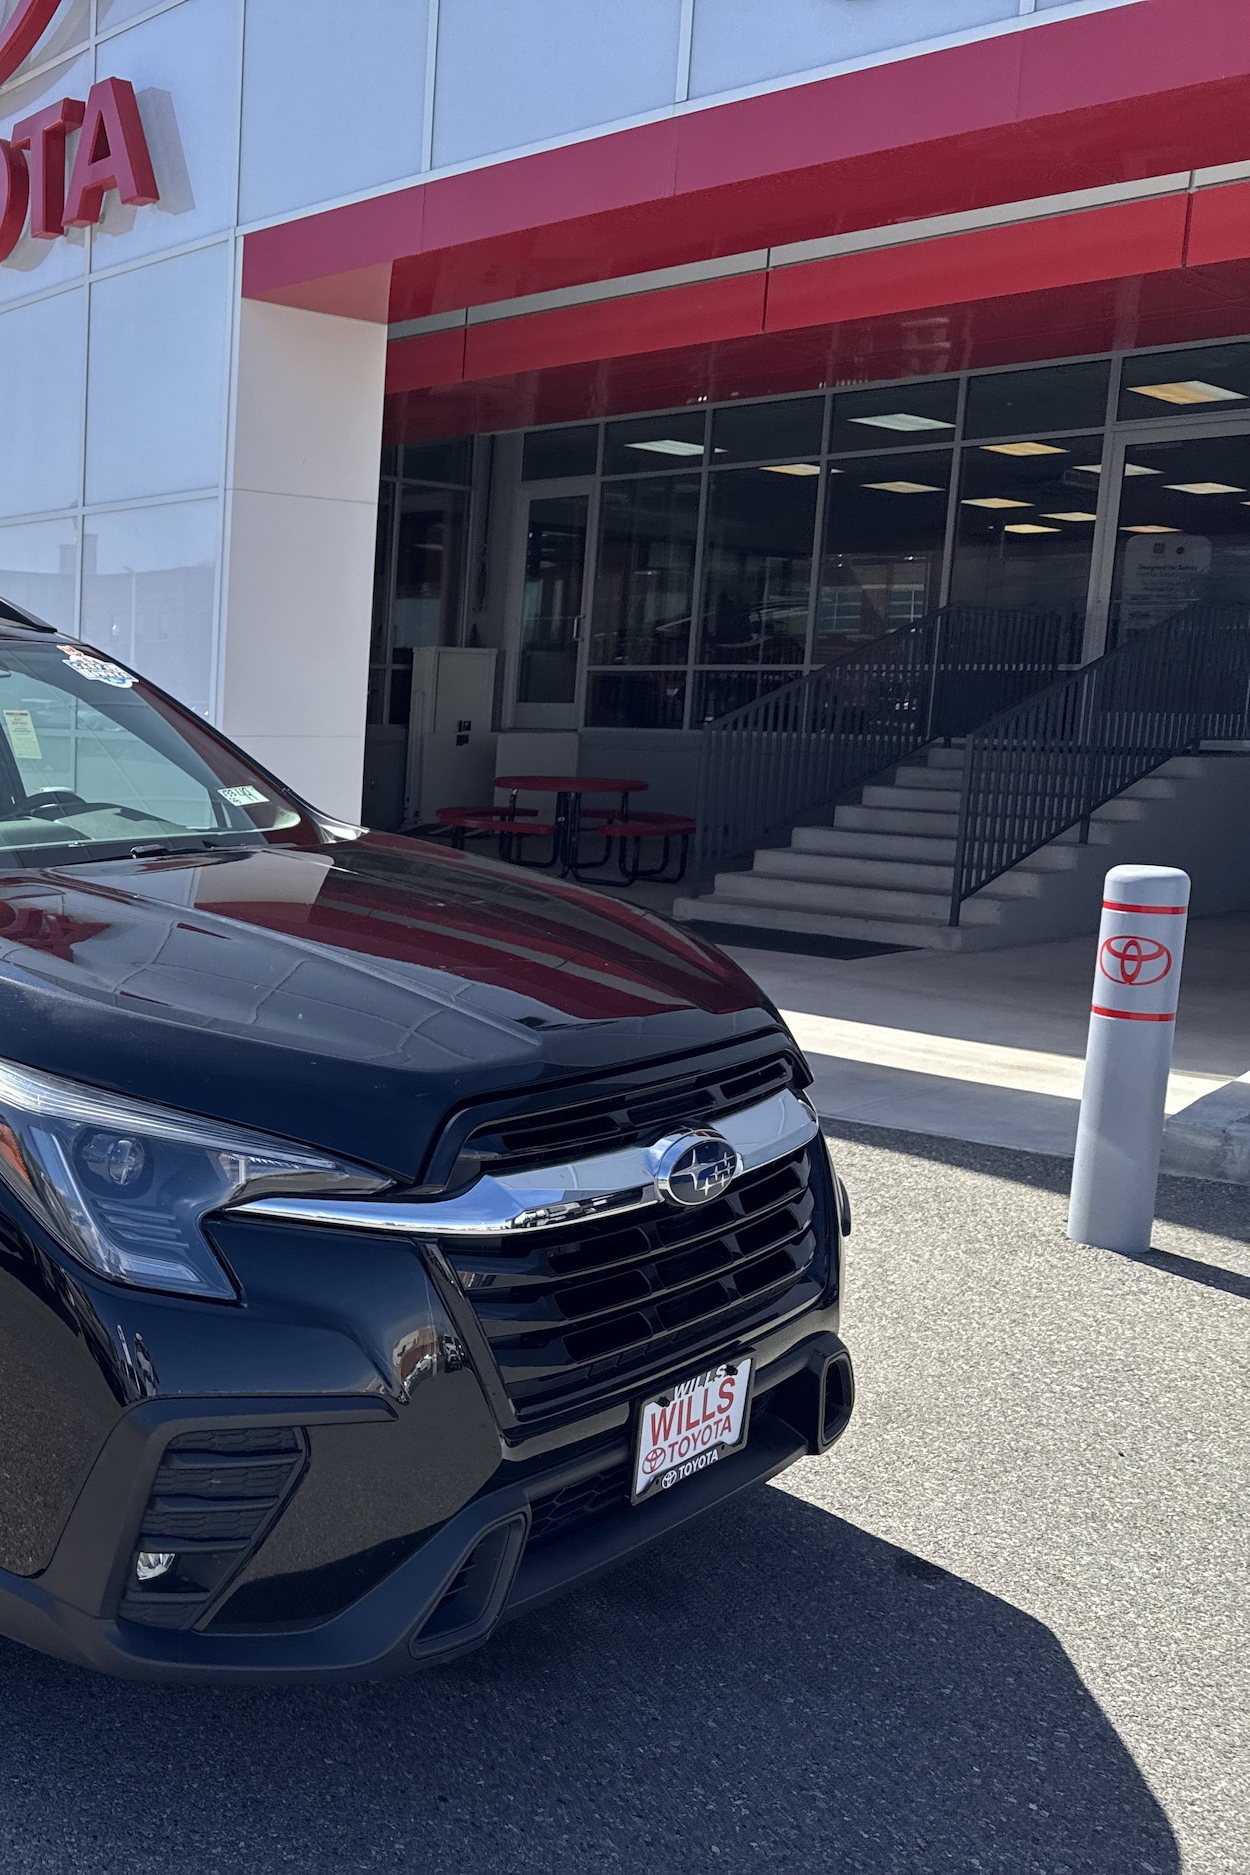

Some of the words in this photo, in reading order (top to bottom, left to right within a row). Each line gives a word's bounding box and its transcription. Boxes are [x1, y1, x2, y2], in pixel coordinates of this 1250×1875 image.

[673, 1364, 727, 1401] WILLS
[651, 1377, 736, 1447] WILLS
[668, 1415, 733, 1463] TOYOTA
[679, 1449, 719, 1479] TOYOTA
